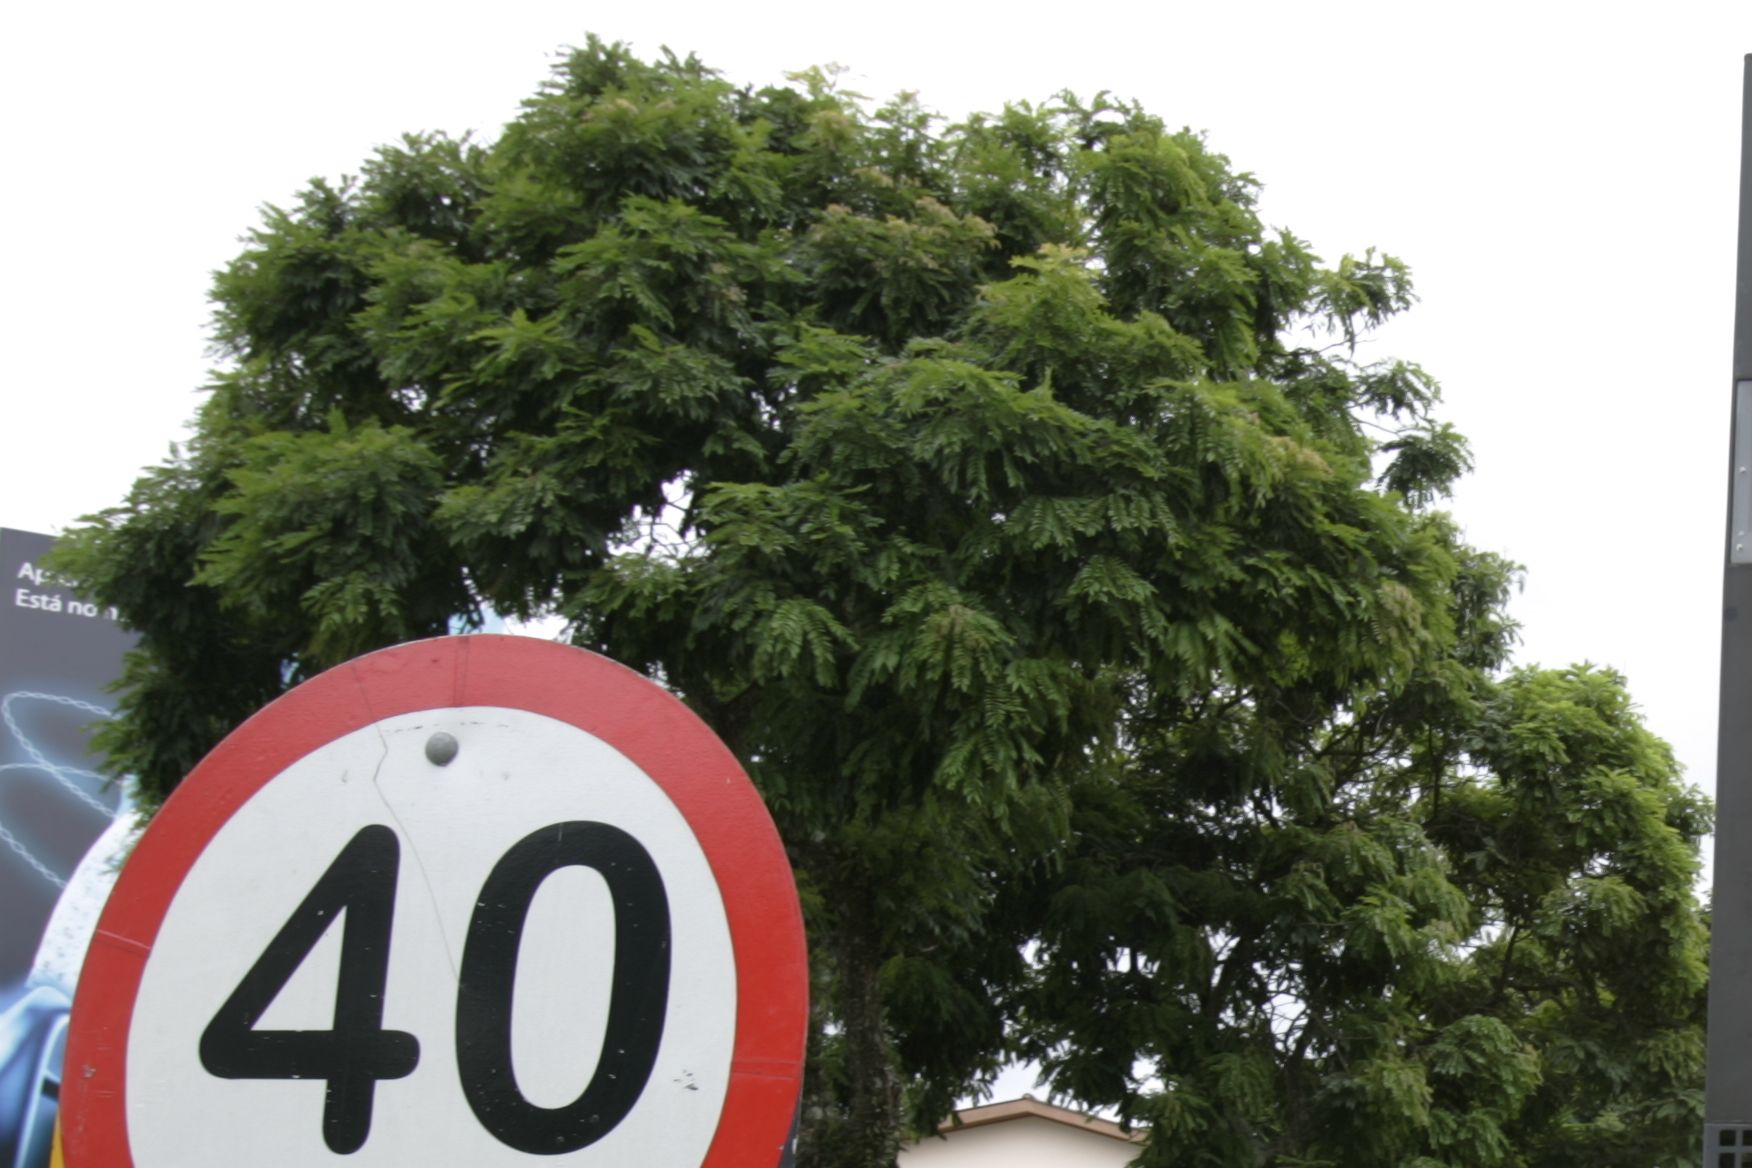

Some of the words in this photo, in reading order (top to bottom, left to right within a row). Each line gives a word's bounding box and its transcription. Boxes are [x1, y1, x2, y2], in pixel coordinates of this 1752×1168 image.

[15, 588, 62, 612] Está
[67, 600, 98, 617] no
[199, 820, 673, 1156] 40
